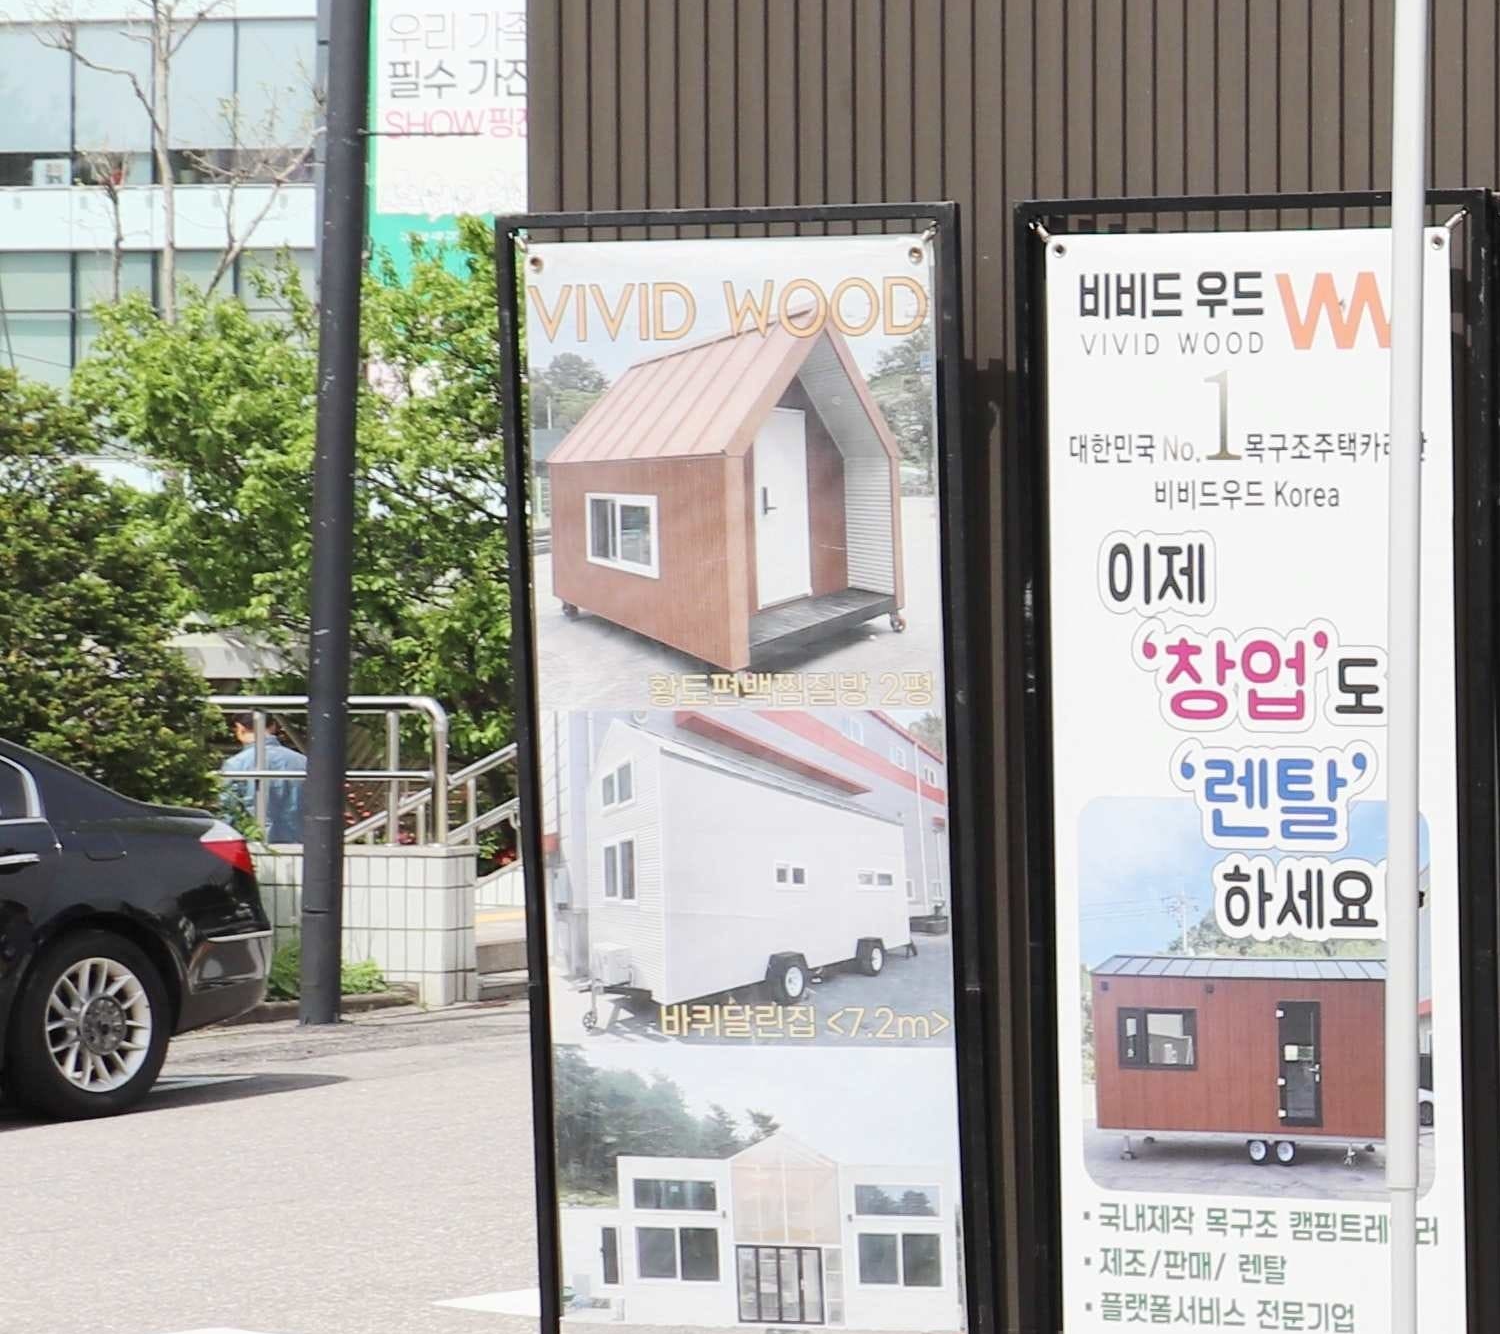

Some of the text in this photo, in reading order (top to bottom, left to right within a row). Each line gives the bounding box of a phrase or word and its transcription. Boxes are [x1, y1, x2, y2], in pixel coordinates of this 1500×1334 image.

[387, 11, 455, 53] 우리
[388, 59, 457, 99] 필수
[527, 275, 930, 343] VIVID WOOD
[1079, 270, 1265, 320] 비비드 우드
[1080, 331, 1264, 356] VIVID WOOD
[1069, 433, 1156, 464] 대한민국
[1245, 432, 1428, 464] 목구조주택카
[1154, 479, 1340, 510] 비비드우드 Korea
[1108, 542, 1206, 605] 이제
[648, 672, 936, 708] 황토편백찜질방 2평
[1222, 864, 1379, 929] 하세요
[660, 1003, 951, 1040] 바퀴달린집 <7.2m>
[1098, 1202, 1440, 1246] 국내제작 목구조 캠핑트레러
[1238, 1253, 1288, 1285] 렌탈
[1100, 1291, 1355, 1334] 플랫폼서비스 전문기업
